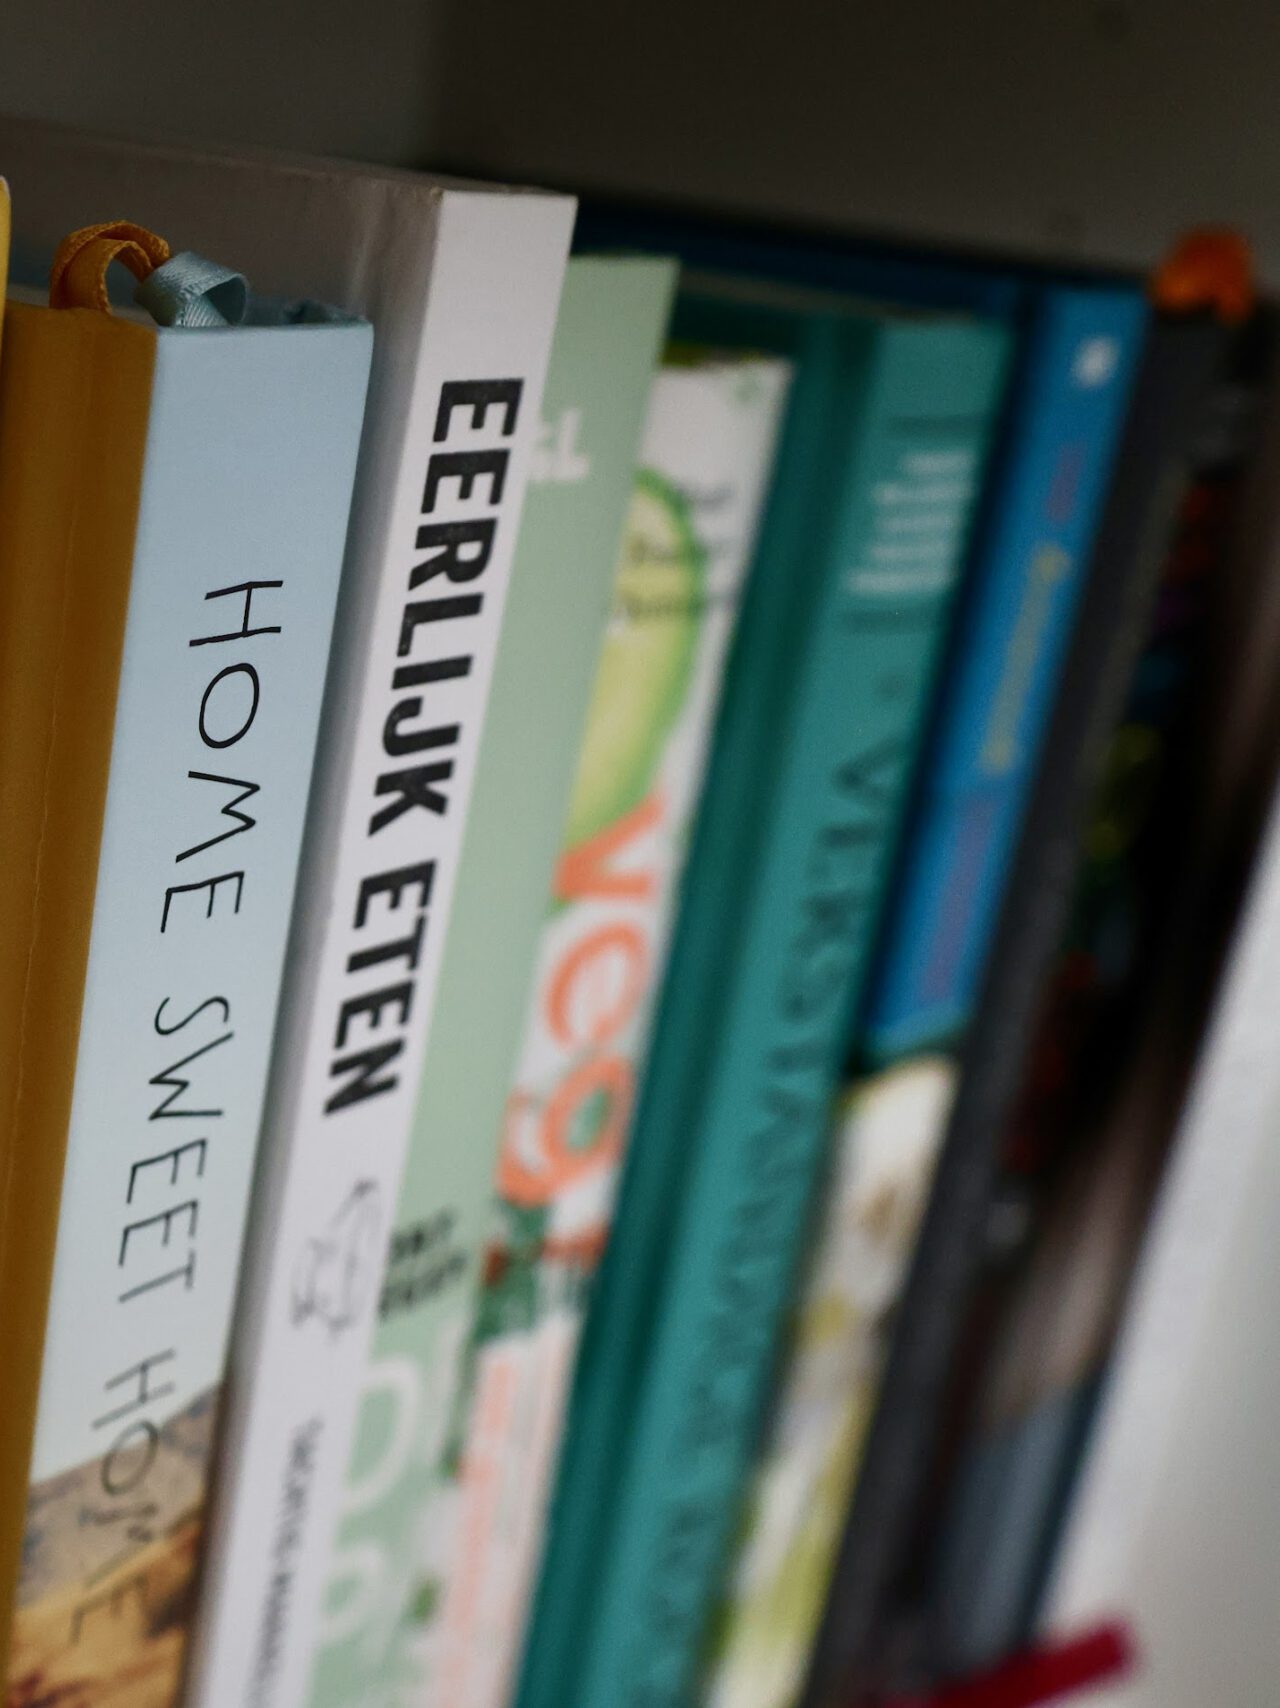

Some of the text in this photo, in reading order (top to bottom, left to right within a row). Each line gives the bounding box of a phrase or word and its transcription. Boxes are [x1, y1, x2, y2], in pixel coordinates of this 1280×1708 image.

[366, 377, 524, 838] EERLIJK
[70, 579, 284, 1646] HOME SWEET HOME
[323, 858, 438, 1117] ETEN
